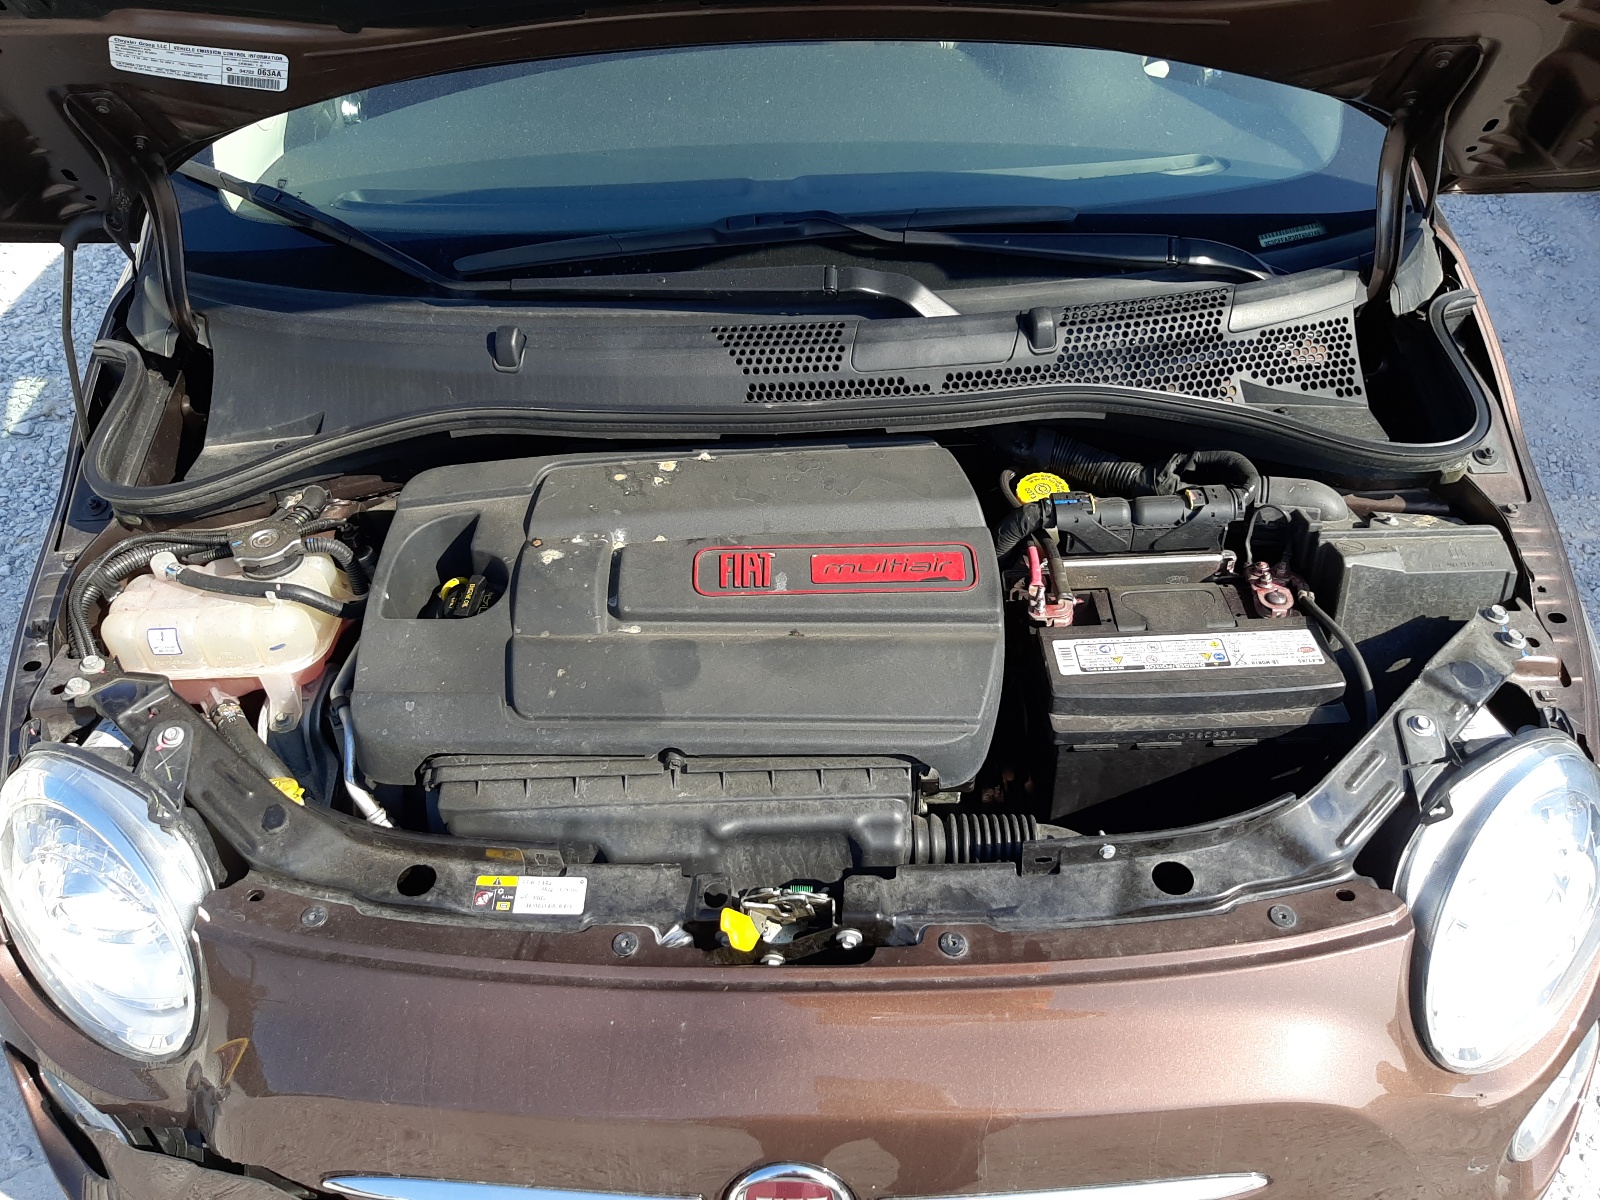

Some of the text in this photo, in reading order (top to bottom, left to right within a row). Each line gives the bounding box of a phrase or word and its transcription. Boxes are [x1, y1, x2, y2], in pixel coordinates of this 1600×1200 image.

[114, 37, 137, 45] Chrysler
[138, 41, 155, 49] Group
[247, 53, 283, 61] INFORMATION
[257, 68, 282, 78] 063AA
[719, 551, 775, 589] FIAT
[823, 556, 952, 576] multiair
